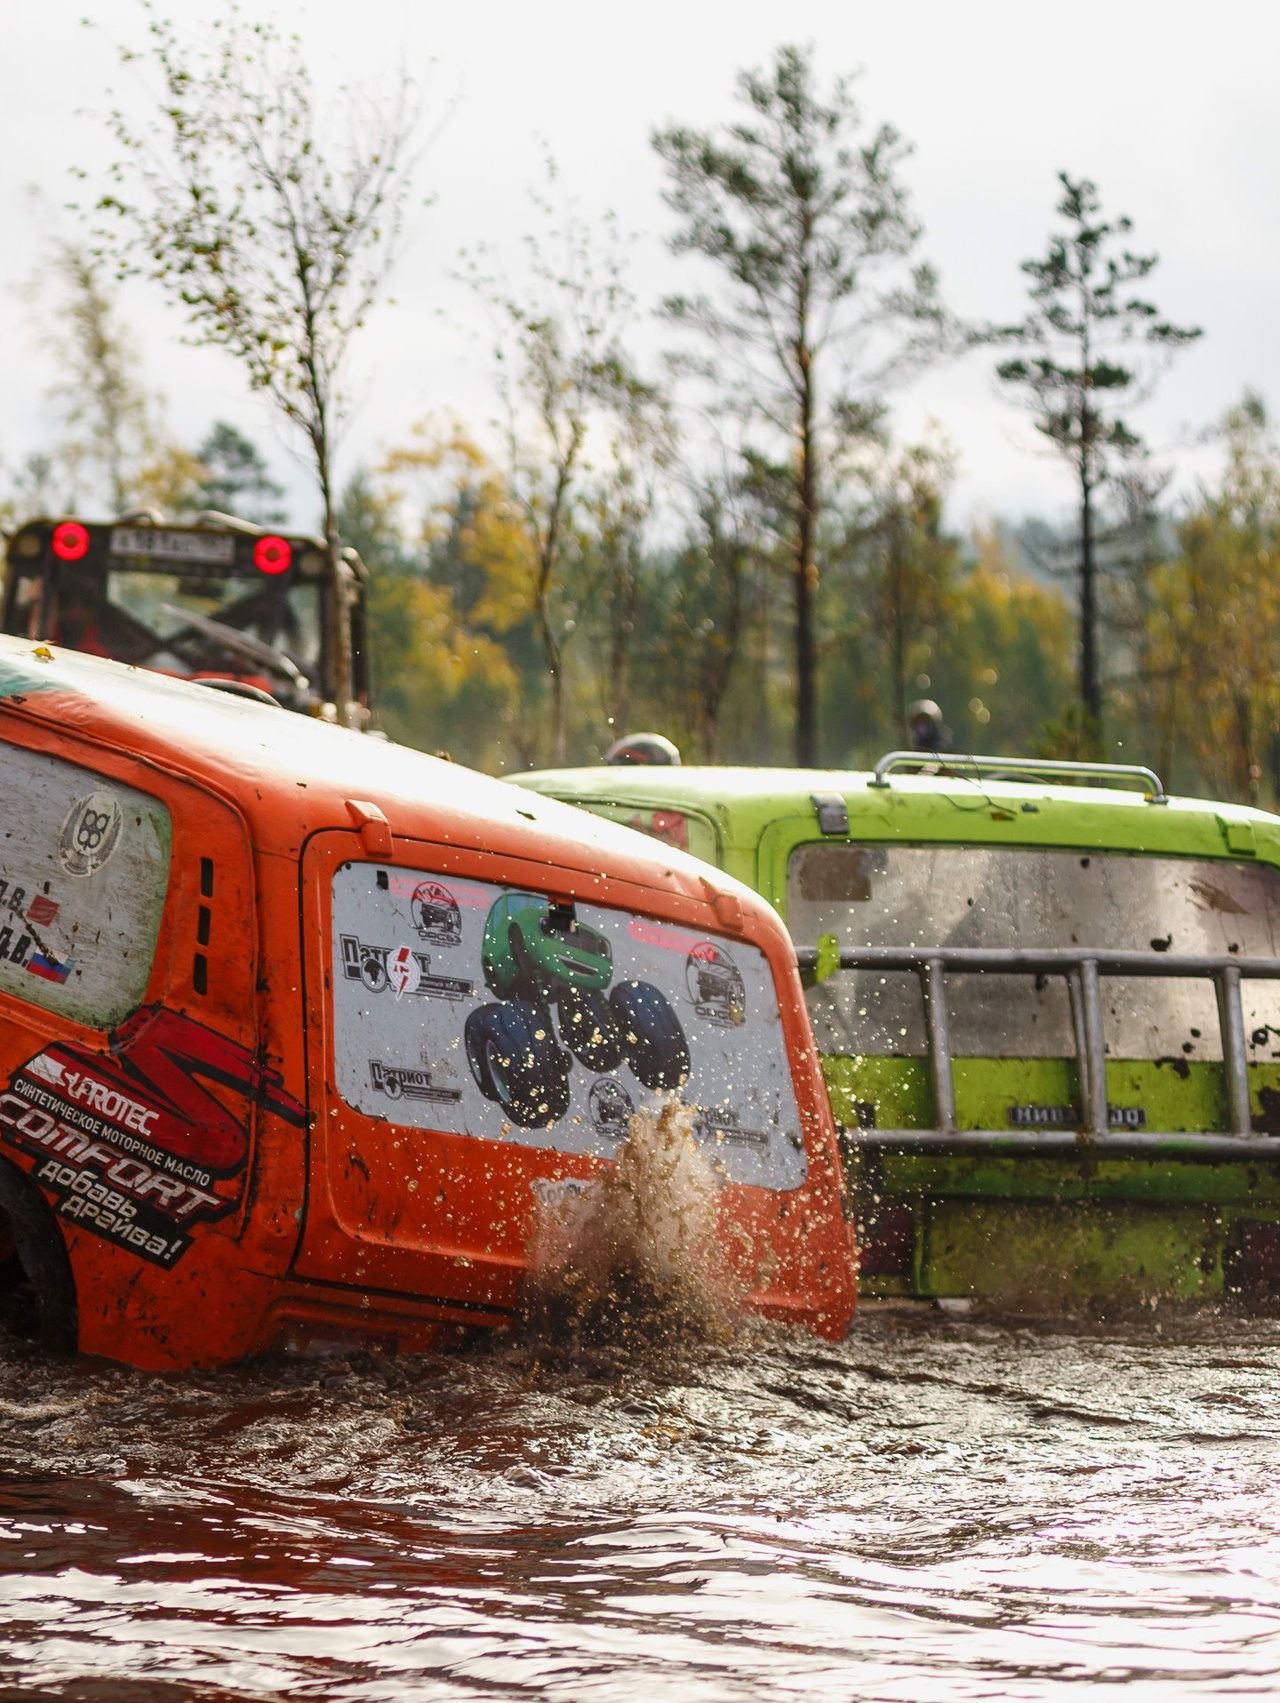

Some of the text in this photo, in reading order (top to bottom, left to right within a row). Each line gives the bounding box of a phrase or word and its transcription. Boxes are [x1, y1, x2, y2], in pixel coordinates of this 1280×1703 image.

[14, 1079, 211, 1188] СИНТЕТИЧЕСКОЕ МОТОРНОЕ МАСЛО
